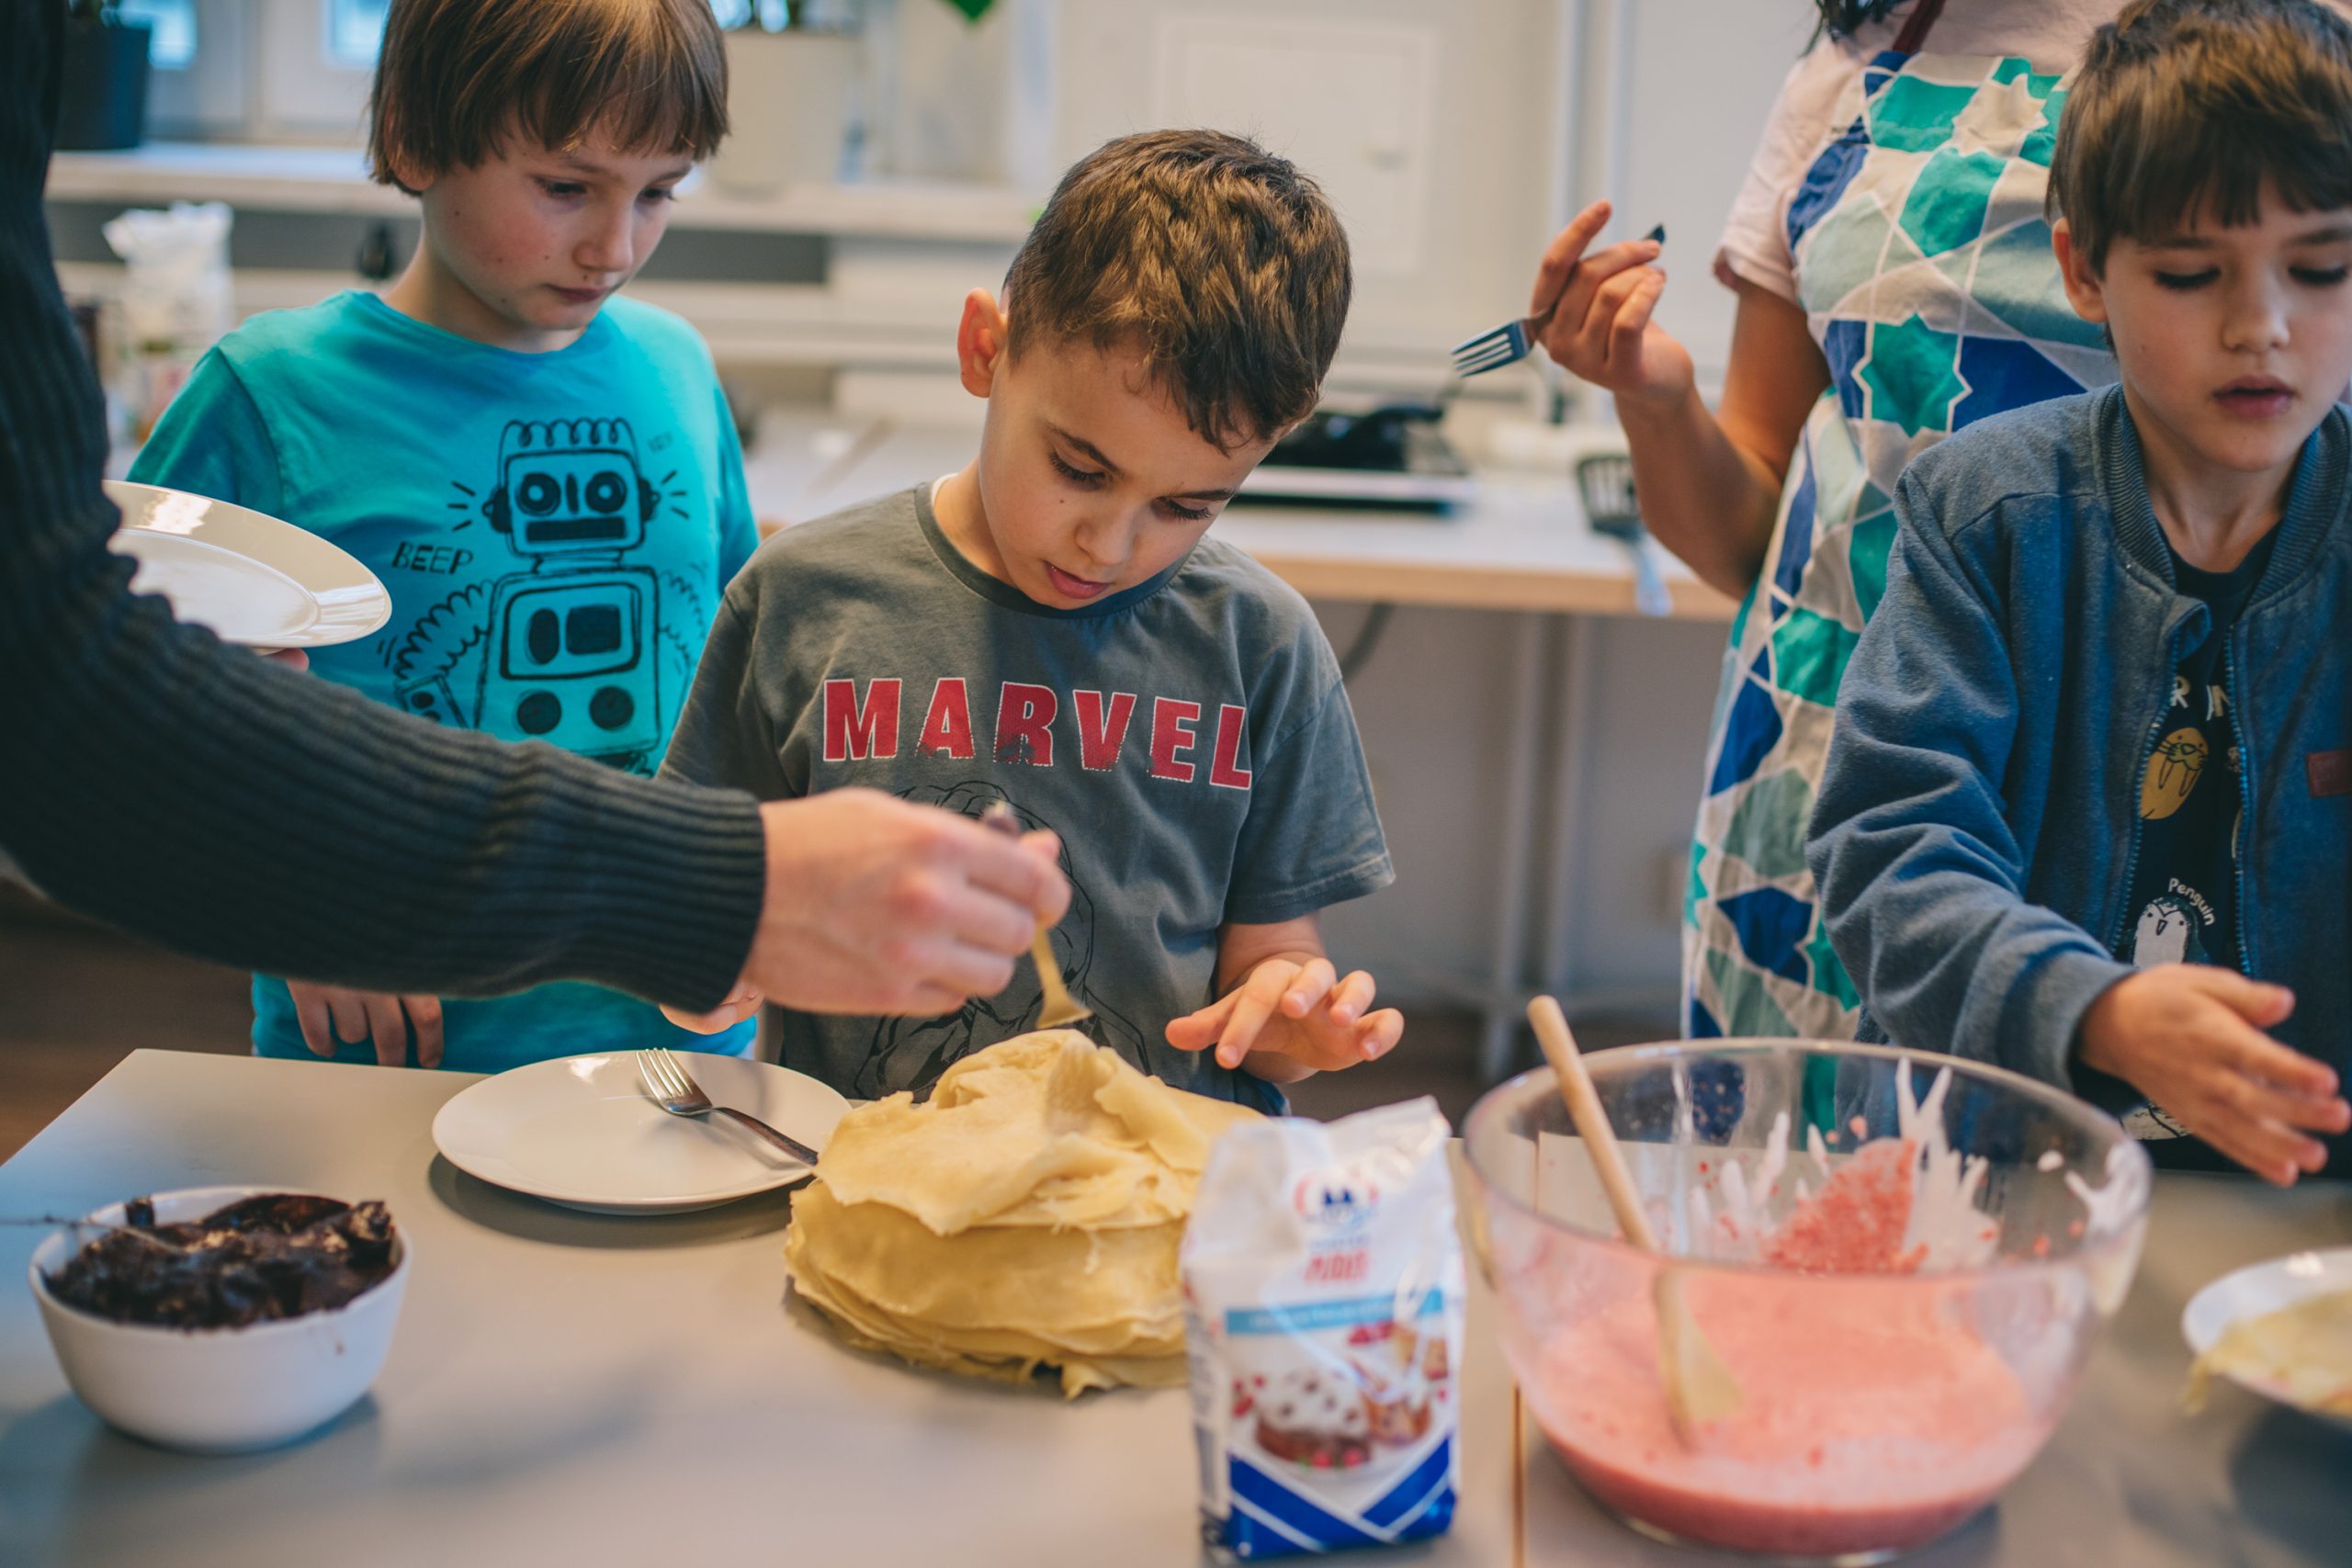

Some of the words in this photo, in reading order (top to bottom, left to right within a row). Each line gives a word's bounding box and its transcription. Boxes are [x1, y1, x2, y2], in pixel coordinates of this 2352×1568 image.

[392, 541, 473, 574] BEEP
[823, 677, 1252, 790] MARVEL
[2168, 877, 2215, 926] Penguin
